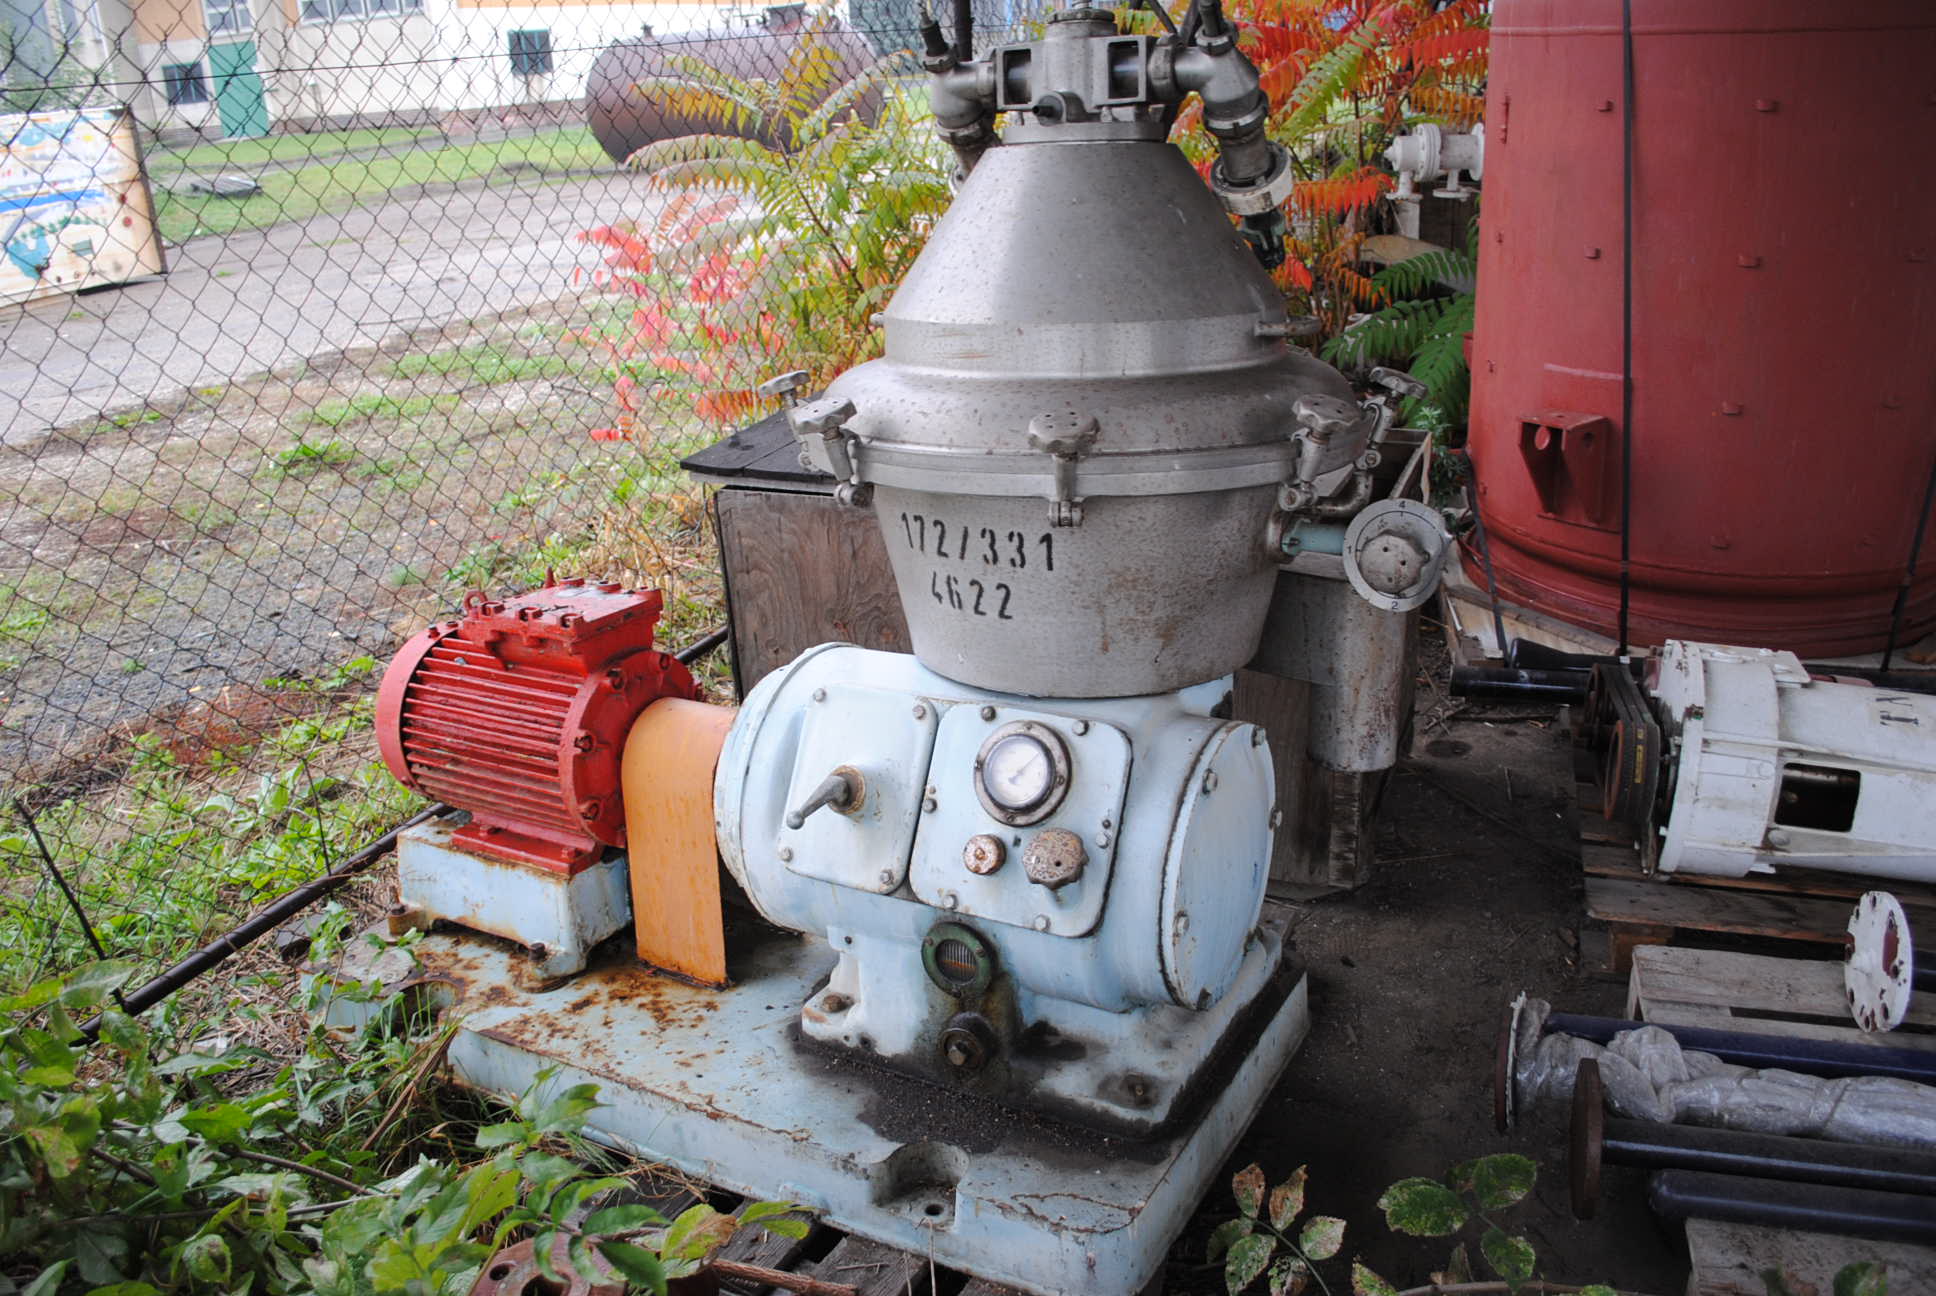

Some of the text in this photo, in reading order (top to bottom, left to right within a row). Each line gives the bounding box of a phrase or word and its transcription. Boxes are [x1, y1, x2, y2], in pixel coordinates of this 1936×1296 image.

[1398, 500, 1406, 508] 4
[901, 512, 1054, 571] 172/331
[932, 571, 1013, 620] 4622
[1391, 601, 1399, 609] 2
